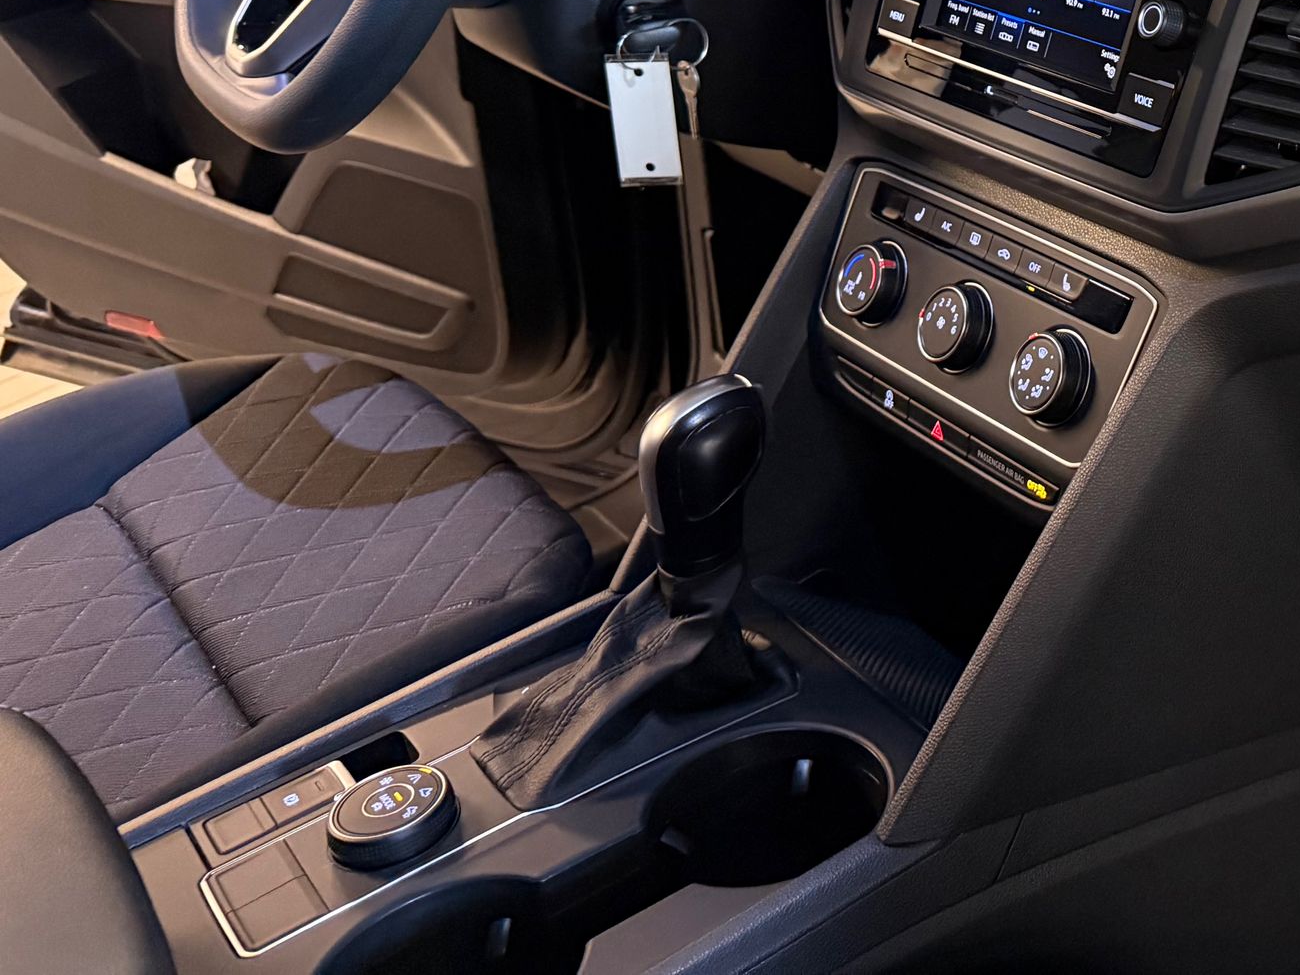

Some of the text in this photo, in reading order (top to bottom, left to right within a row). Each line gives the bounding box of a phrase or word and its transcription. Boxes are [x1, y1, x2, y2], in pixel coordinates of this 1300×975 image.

[889, 10, 905, 23] MENU
[972, 8, 988, 19] Station
[948, 14, 960, 26] FM
[1001, 17, 1018, 29] Presets
[1028, 26, 1045, 38] Manual
[1101, 49, 1120, 63] Setting
[1134, 93, 1154, 108] VOICE
[1028, 261, 1042, 274] OFF
[932, 302, 937, 312] 1
[939, 297, 945, 307] 2
[946, 297, 952, 307] 3
[951, 304, 957, 314] 4
[952, 313, 959, 323] 5
[951, 325, 957, 335] 6
[977, 449, 1006, 472] PASSENGER
[1005, 467, 1014, 478] AIR
[1014, 471, 1025, 485] BAG
[379, 793, 396, 810] MODE
